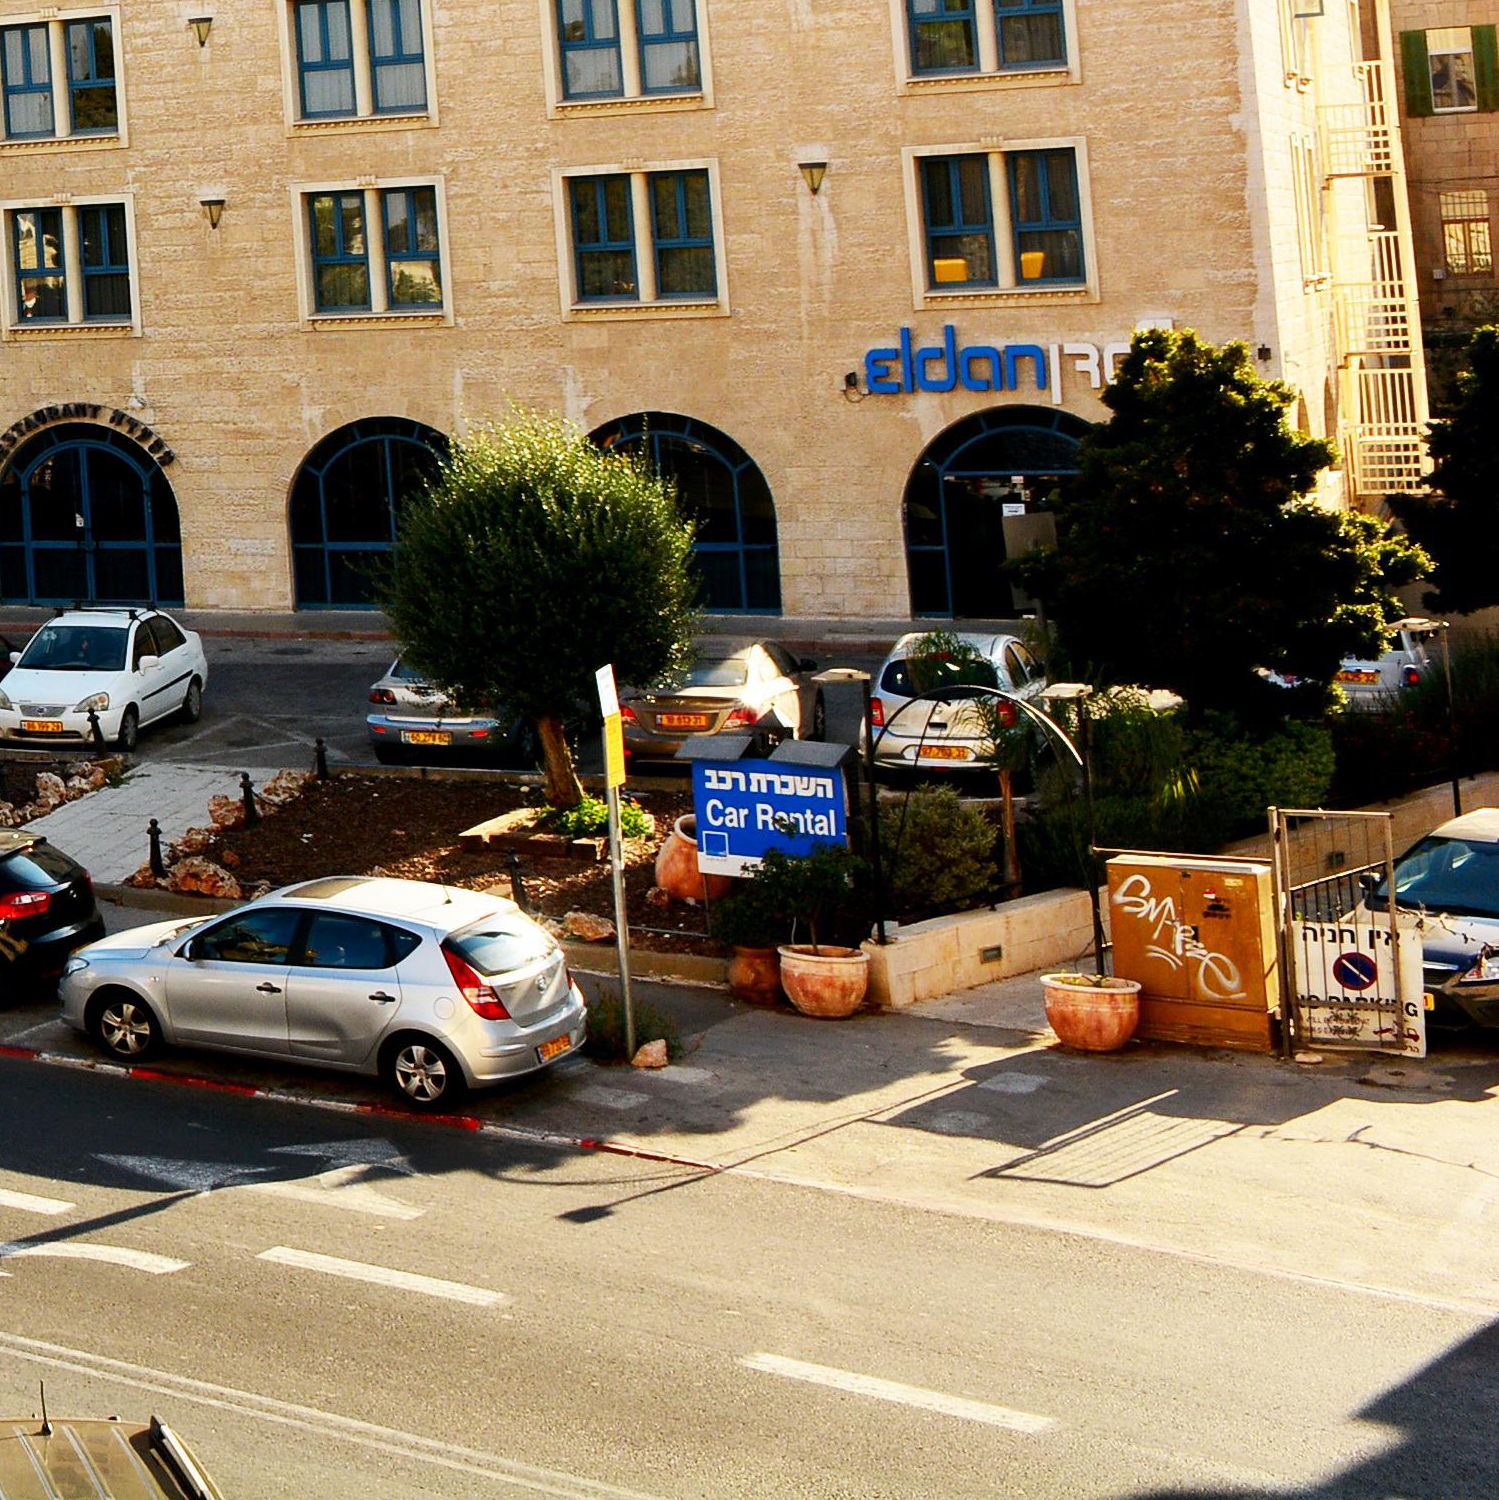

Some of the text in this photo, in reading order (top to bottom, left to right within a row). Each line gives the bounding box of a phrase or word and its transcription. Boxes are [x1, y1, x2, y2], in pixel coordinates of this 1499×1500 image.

[704, 769, 834, 798] השכרת רכב
[706, 798, 749, 829] Car
[1302, 926, 1401, 949] אין חניה
